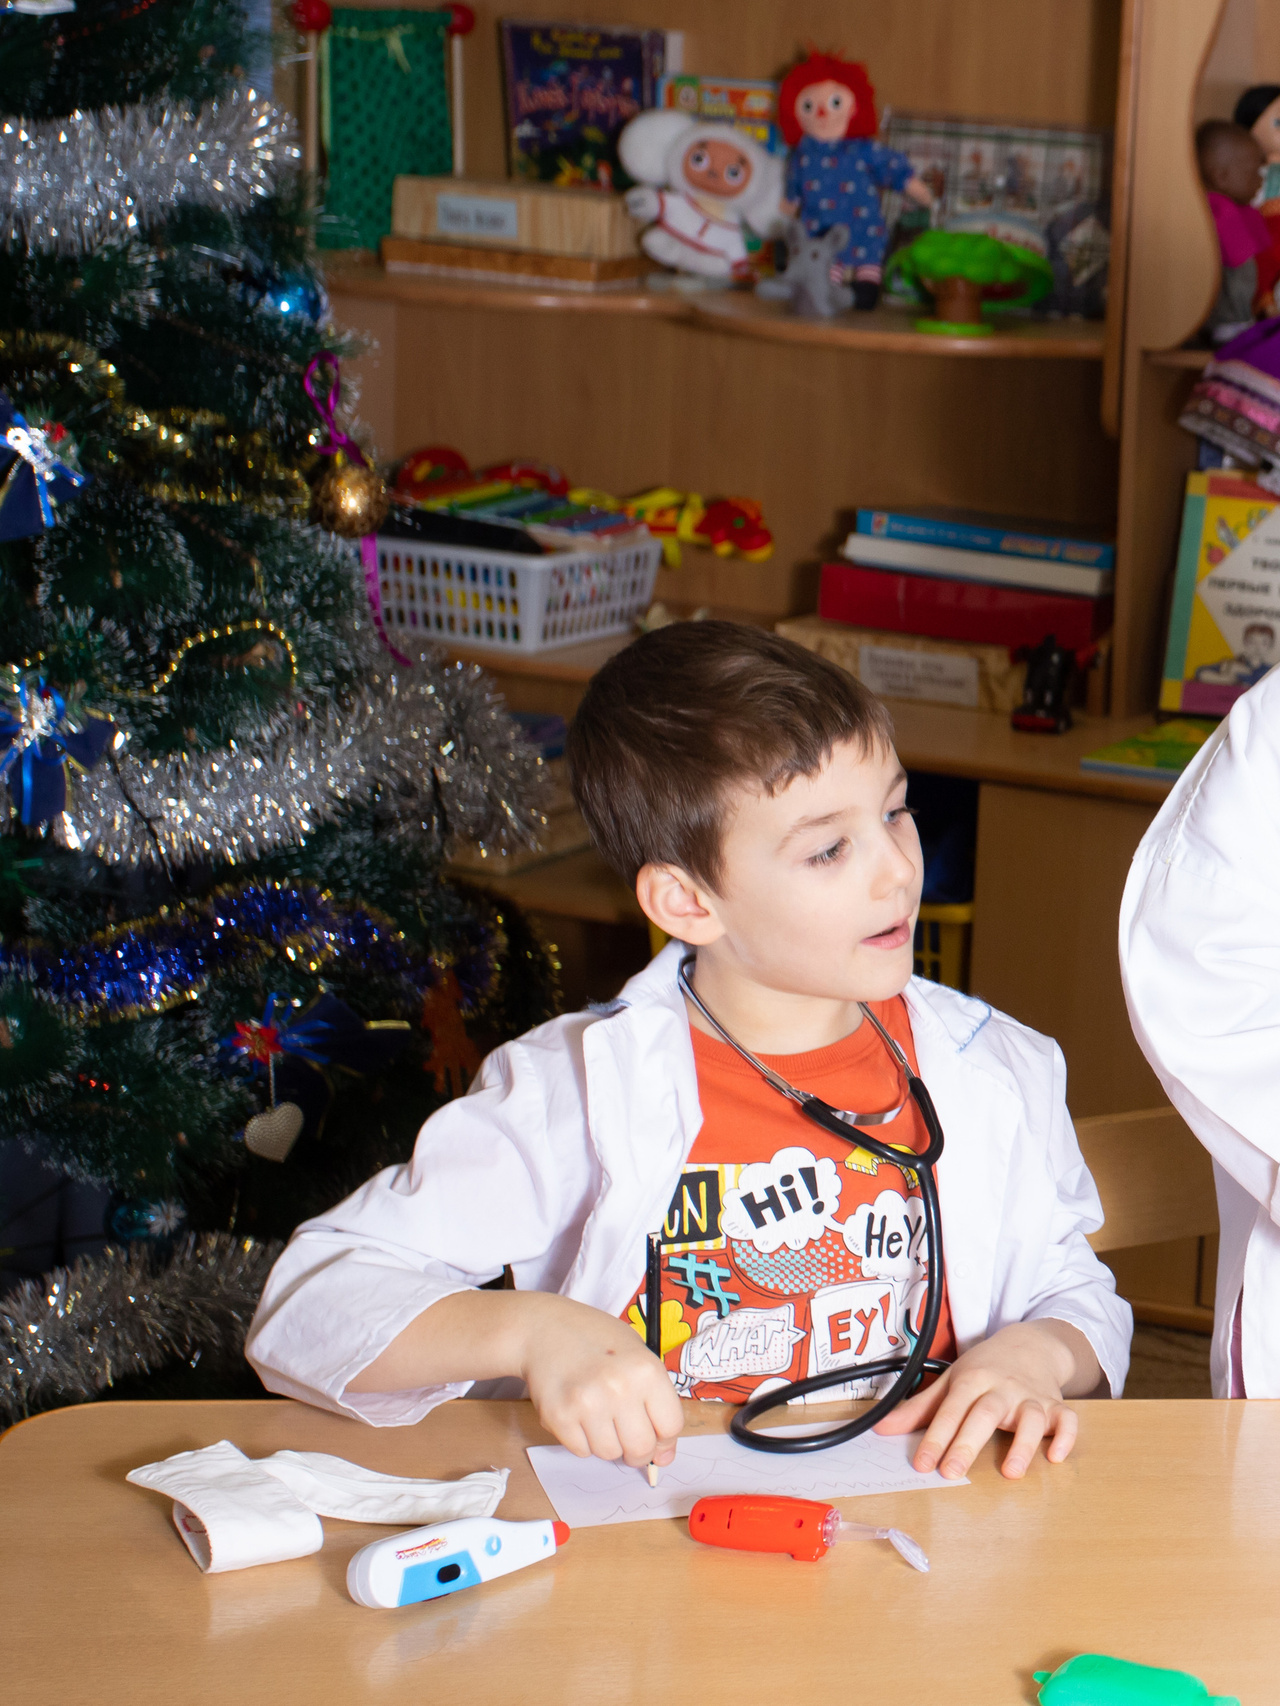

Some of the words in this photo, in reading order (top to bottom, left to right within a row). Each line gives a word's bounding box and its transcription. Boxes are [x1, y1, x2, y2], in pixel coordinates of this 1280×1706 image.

[740, 1166, 825, 1230] Hi!
[690, 1319, 785, 1367] WHAT
[827, 1291, 899, 1355] EY!
